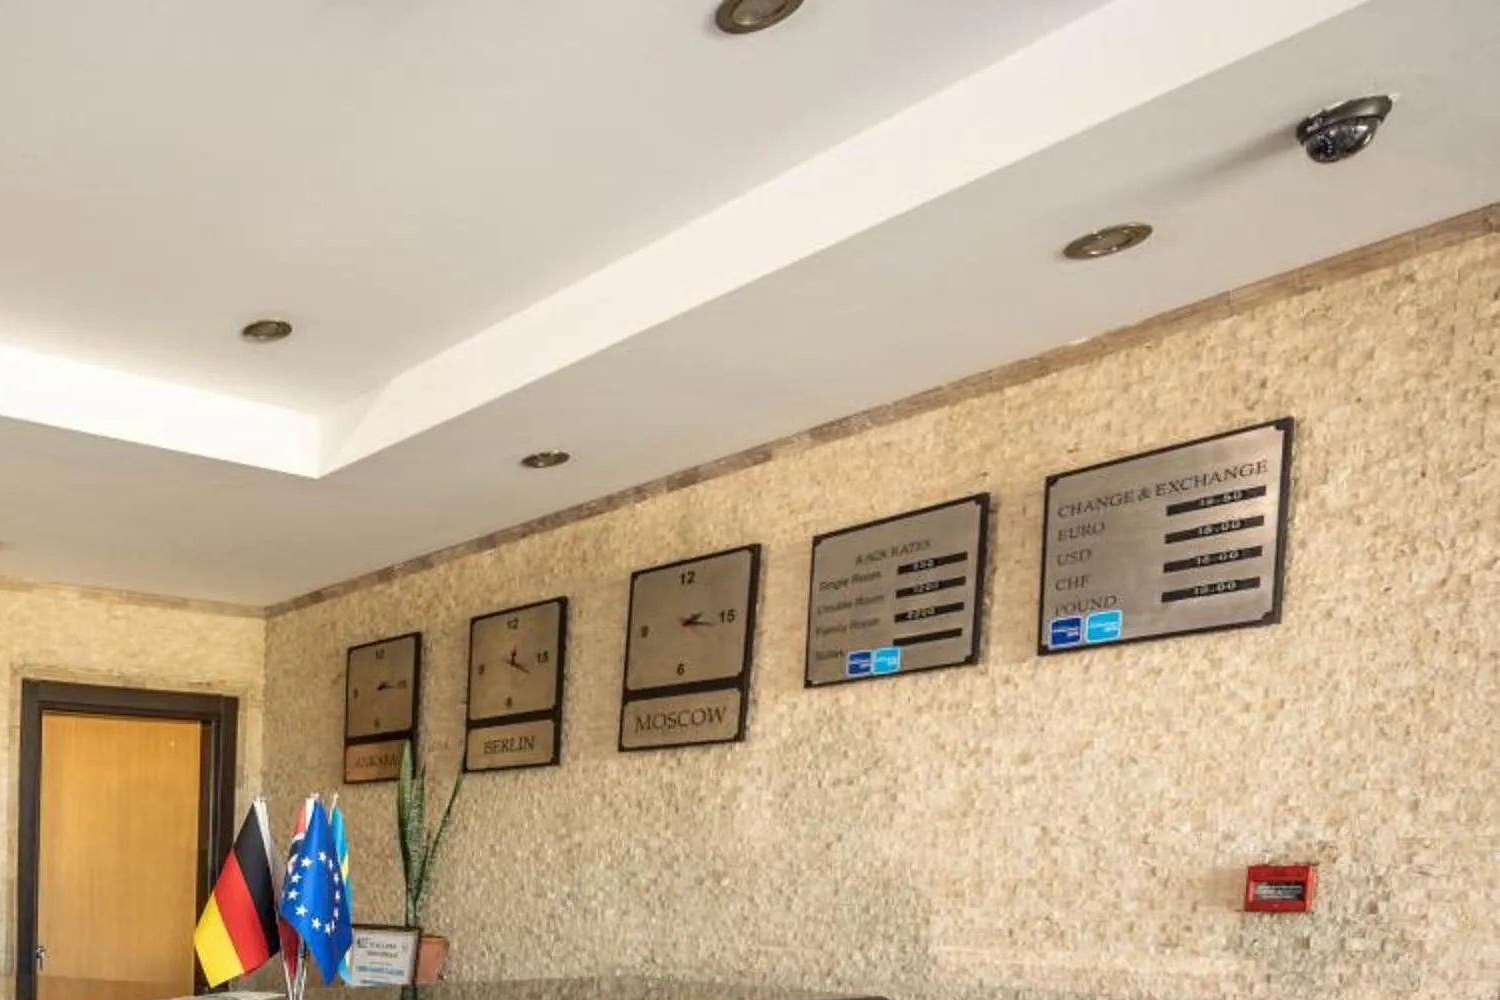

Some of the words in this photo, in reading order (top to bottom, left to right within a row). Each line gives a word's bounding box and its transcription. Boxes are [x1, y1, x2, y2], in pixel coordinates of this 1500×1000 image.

[1057, 488, 1136, 519] CHANGE
[1137, 486, 1150, 500] &
[1155, 460, 1268, 497] EXCHANGE
[1058, 521, 1106, 543] EURO
[1057, 548, 1092, 567] USD
[680, 571, 695, 585] 12
[1055, 575, 1090, 592] CHF
[507, 618, 518, 630] 12
[720, 609, 736, 623] 15
[676, 662, 685, 676] 6
[635, 705, 727, 733] MOSCOW
[484, 735, 535, 755] BERLIN
